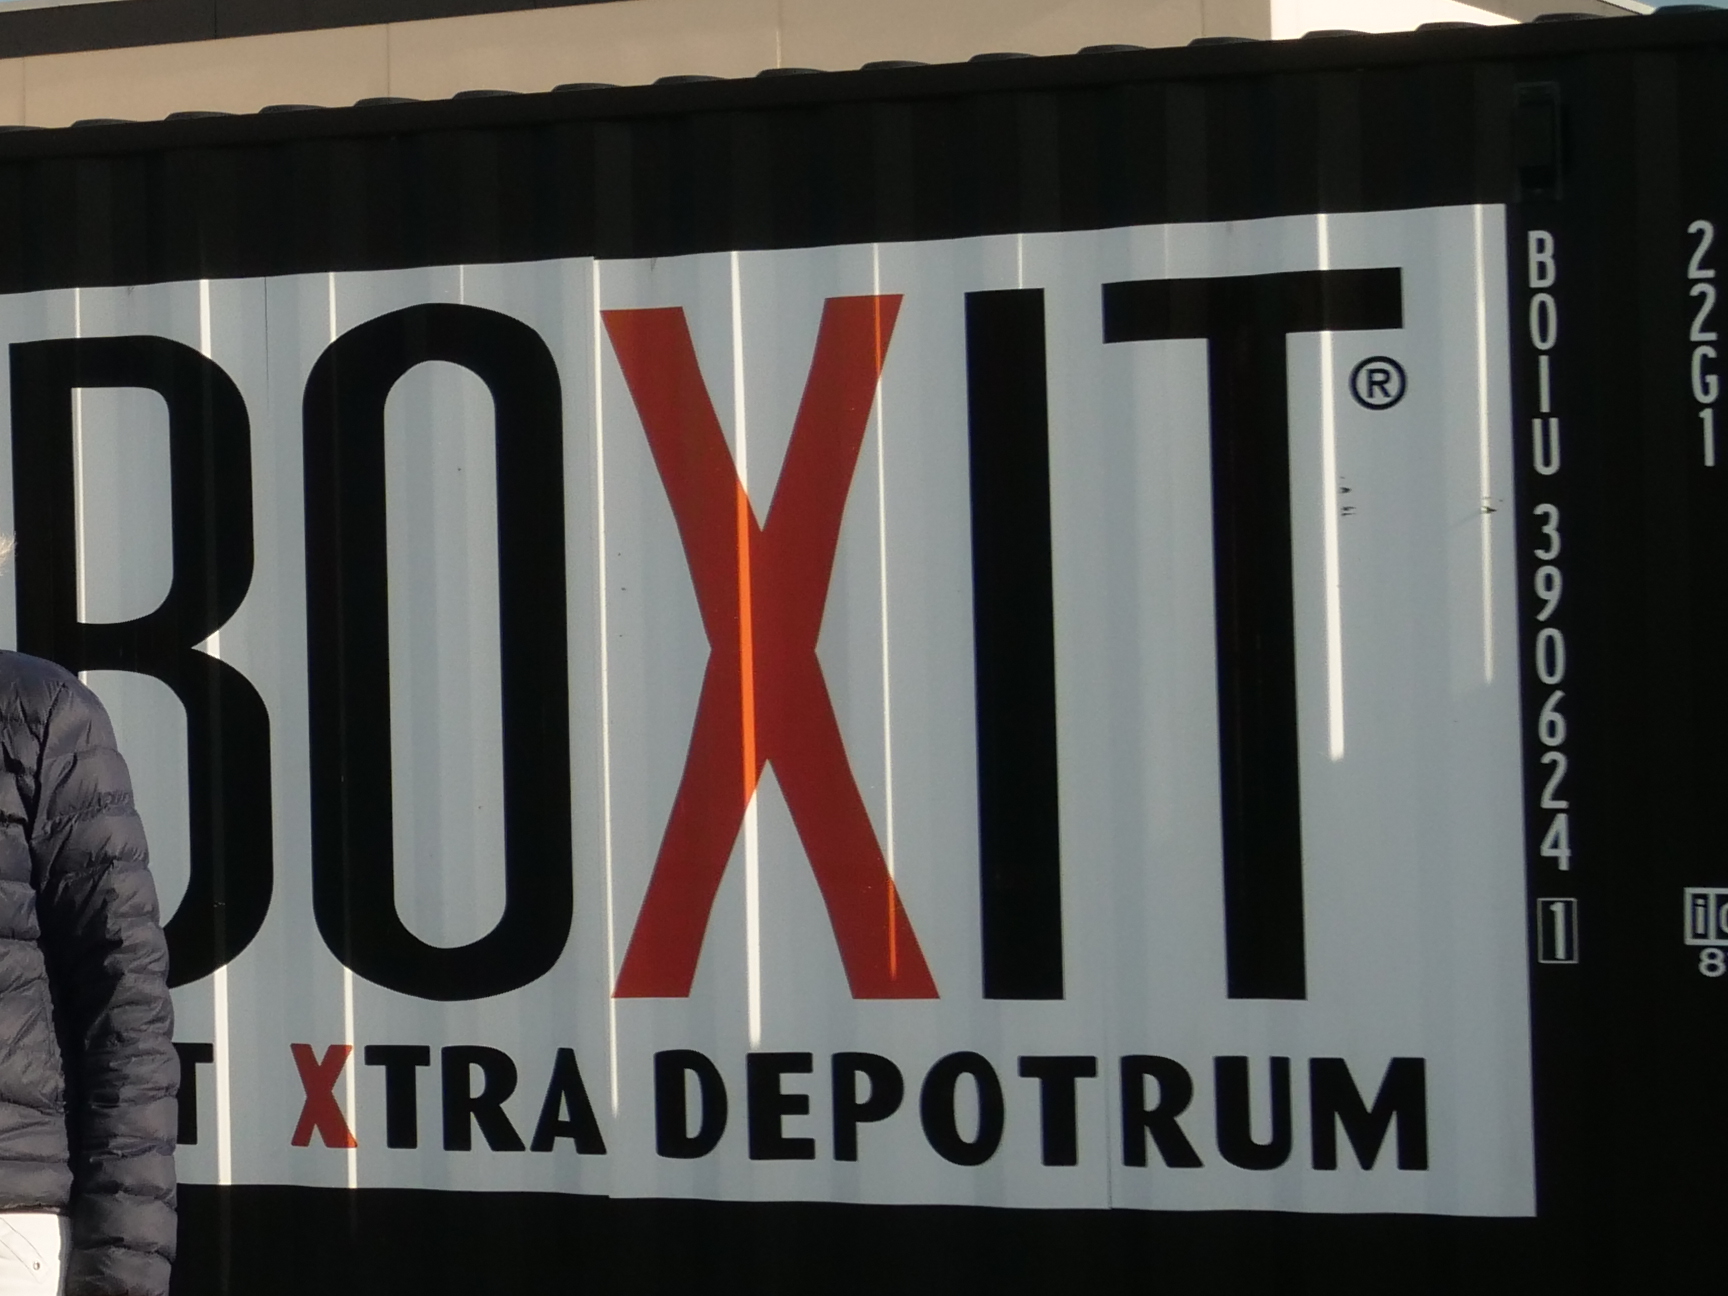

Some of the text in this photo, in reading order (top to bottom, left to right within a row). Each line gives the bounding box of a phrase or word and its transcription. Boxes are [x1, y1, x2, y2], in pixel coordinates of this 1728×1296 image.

[1528, 231, 1559, 475] BOIU
[1687, 221, 1720, 466] 22G1
[10, 269, 1401, 1001] BOXIT
[1532, 503, 1571, 871] 390624
[290, 1042, 607, 1155] XTRA
[654, 1050, 1430, 1172] DEPOTRUM
